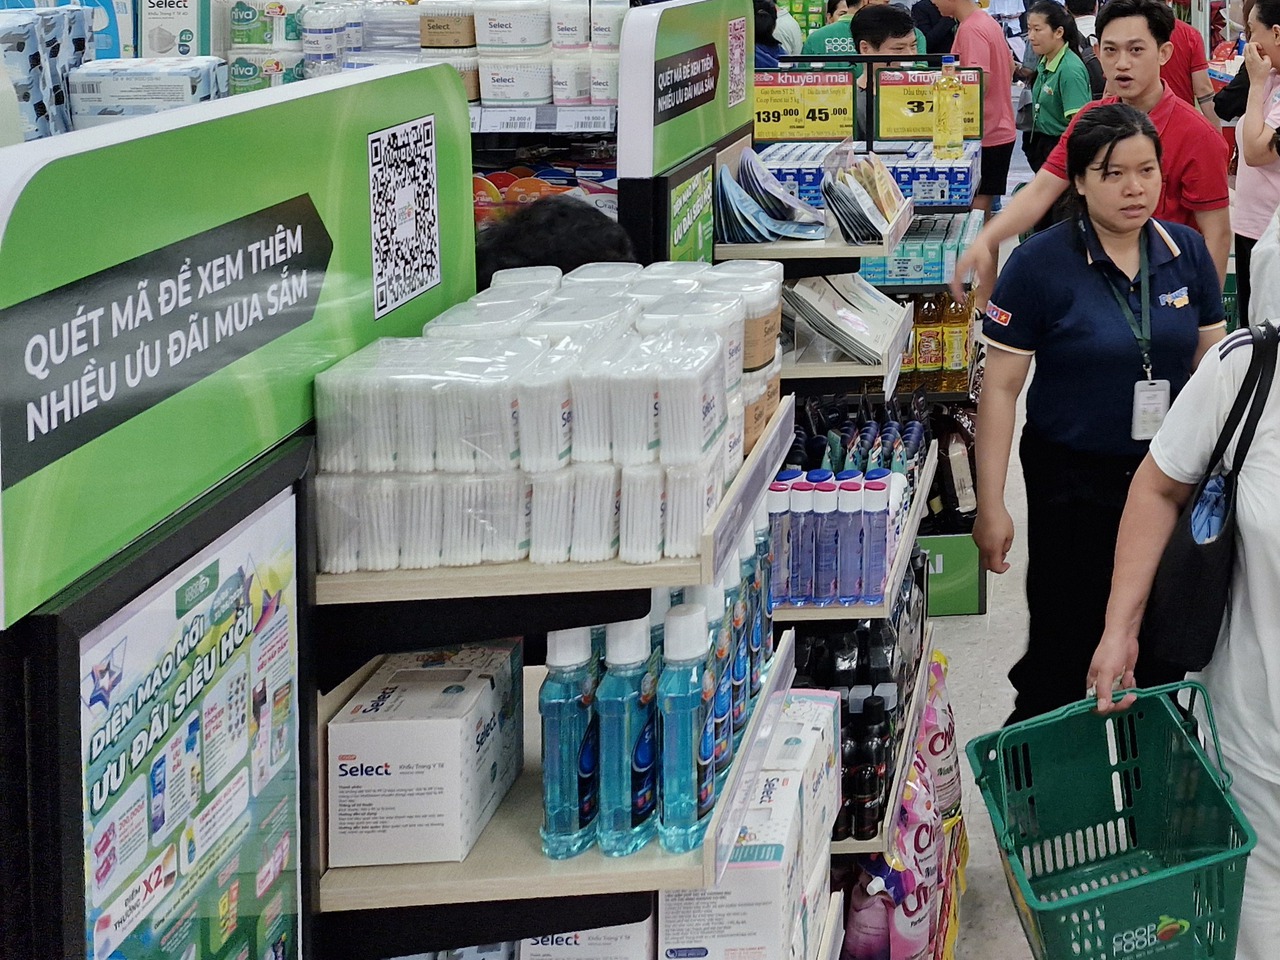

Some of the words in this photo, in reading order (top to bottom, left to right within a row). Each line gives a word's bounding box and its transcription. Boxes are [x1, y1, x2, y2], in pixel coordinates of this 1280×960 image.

[232, 8, 254, 20] niva
[427, 22, 450, 30] Select
[488, 21, 513, 29] Select
[825, 37, 854, 45] COOP
[231, 64, 254, 76] niva
[491, 76, 515, 84] Select
[24, 307, 104, 381] QUÉT
[111, 280, 153, 333] MÃ
[158, 258, 193, 318] ĐỂ
[197, 252, 244, 300] XEM
[248, 225, 304, 274] THÊM
[26, 358, 117, 443] NHIỀU
[125, 338, 162, 389] ƯU
[167, 316, 210, 368] ĐÃI
[215, 296, 263, 343] MUA
[267, 267, 308, 317] SẮM
[91, 696, 135, 763] DIỆN
[135, 653, 174, 712] MẠO
[174, 614, 204, 665] MỚI
[362, 685, 399, 714] Select
[91, 750, 127, 815] ƯU
[130, 700, 170, 771] ĐÃI
[172, 644, 217, 722] SIÊU
[219, 604, 254, 669] HỜI
[338, 762, 392, 777] Select
[759, 778, 780, 805] Select
[142, 864, 164, 902] X2
[530, 933, 581, 947] Select
